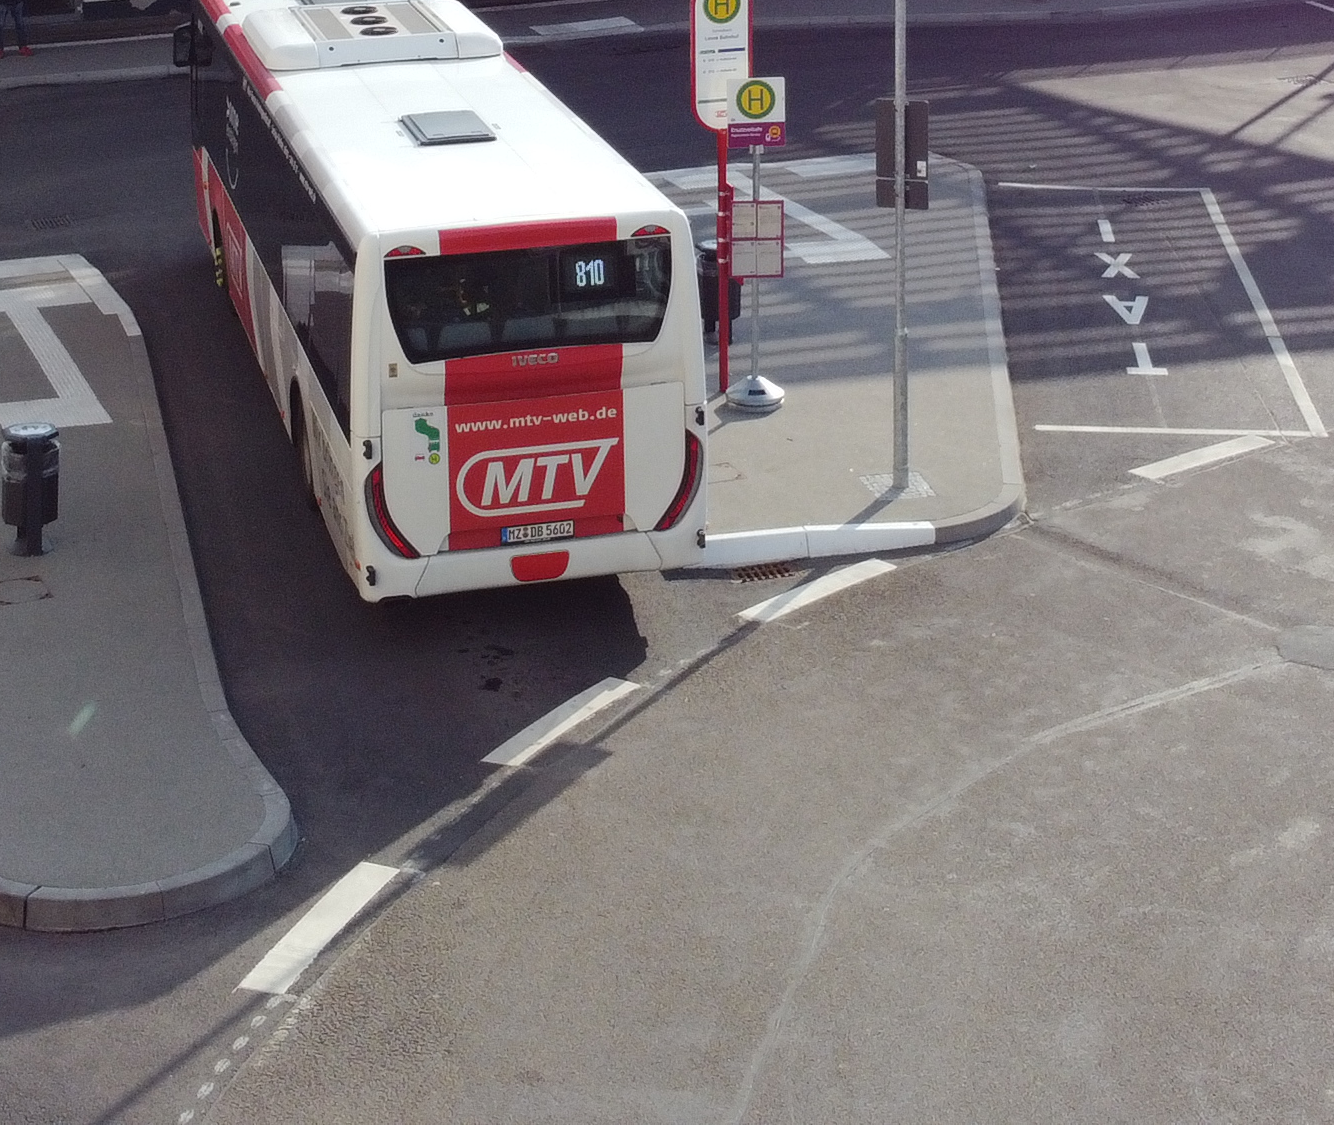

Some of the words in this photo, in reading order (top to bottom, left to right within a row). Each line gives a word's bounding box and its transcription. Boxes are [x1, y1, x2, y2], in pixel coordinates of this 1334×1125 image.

[575, 258, 605, 287] 810
[511, 352, 559, 367] IVECO
[455, 406, 618, 434] www.mtv-web.de
[480, 437, 620, 507] MTV
[508, 528, 522, 540] MZ
[530, 526, 544, 538] DB
[545, 523, 572, 536] 5602
